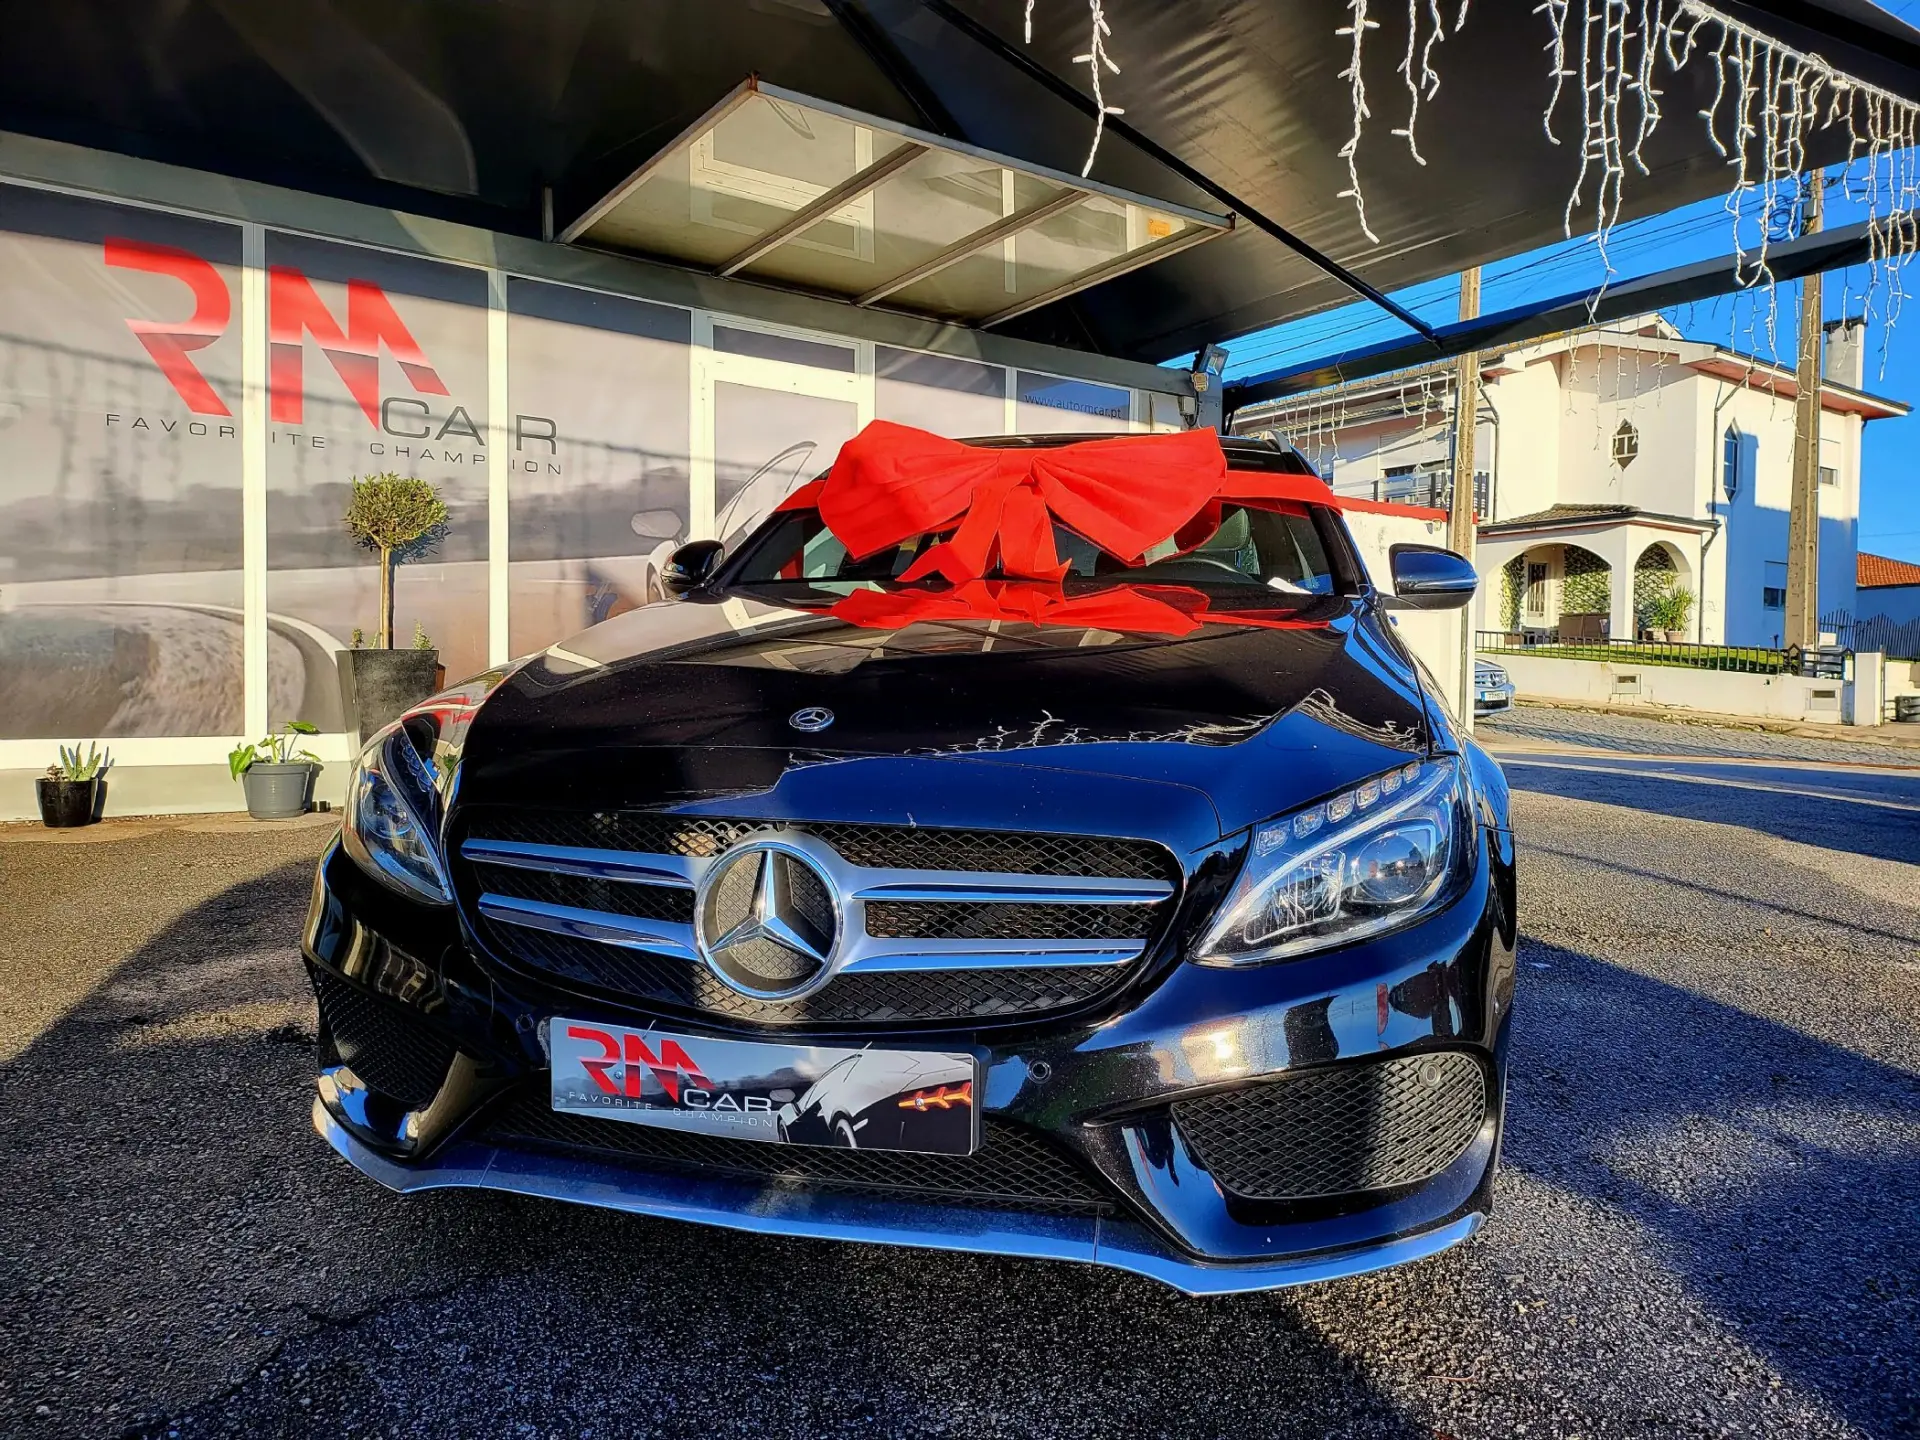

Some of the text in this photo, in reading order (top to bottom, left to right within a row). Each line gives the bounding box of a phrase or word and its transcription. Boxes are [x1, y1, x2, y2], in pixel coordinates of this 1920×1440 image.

[1025, 394, 1122, 419] www.autormcar.pt
[106, 413, 562, 475] FAVORITE CHAMPION
[381, 396, 557, 455] CAR
[568, 1091, 773, 1128] FAVORITE CHAMPION
[683, 1088, 772, 1116] CAR
